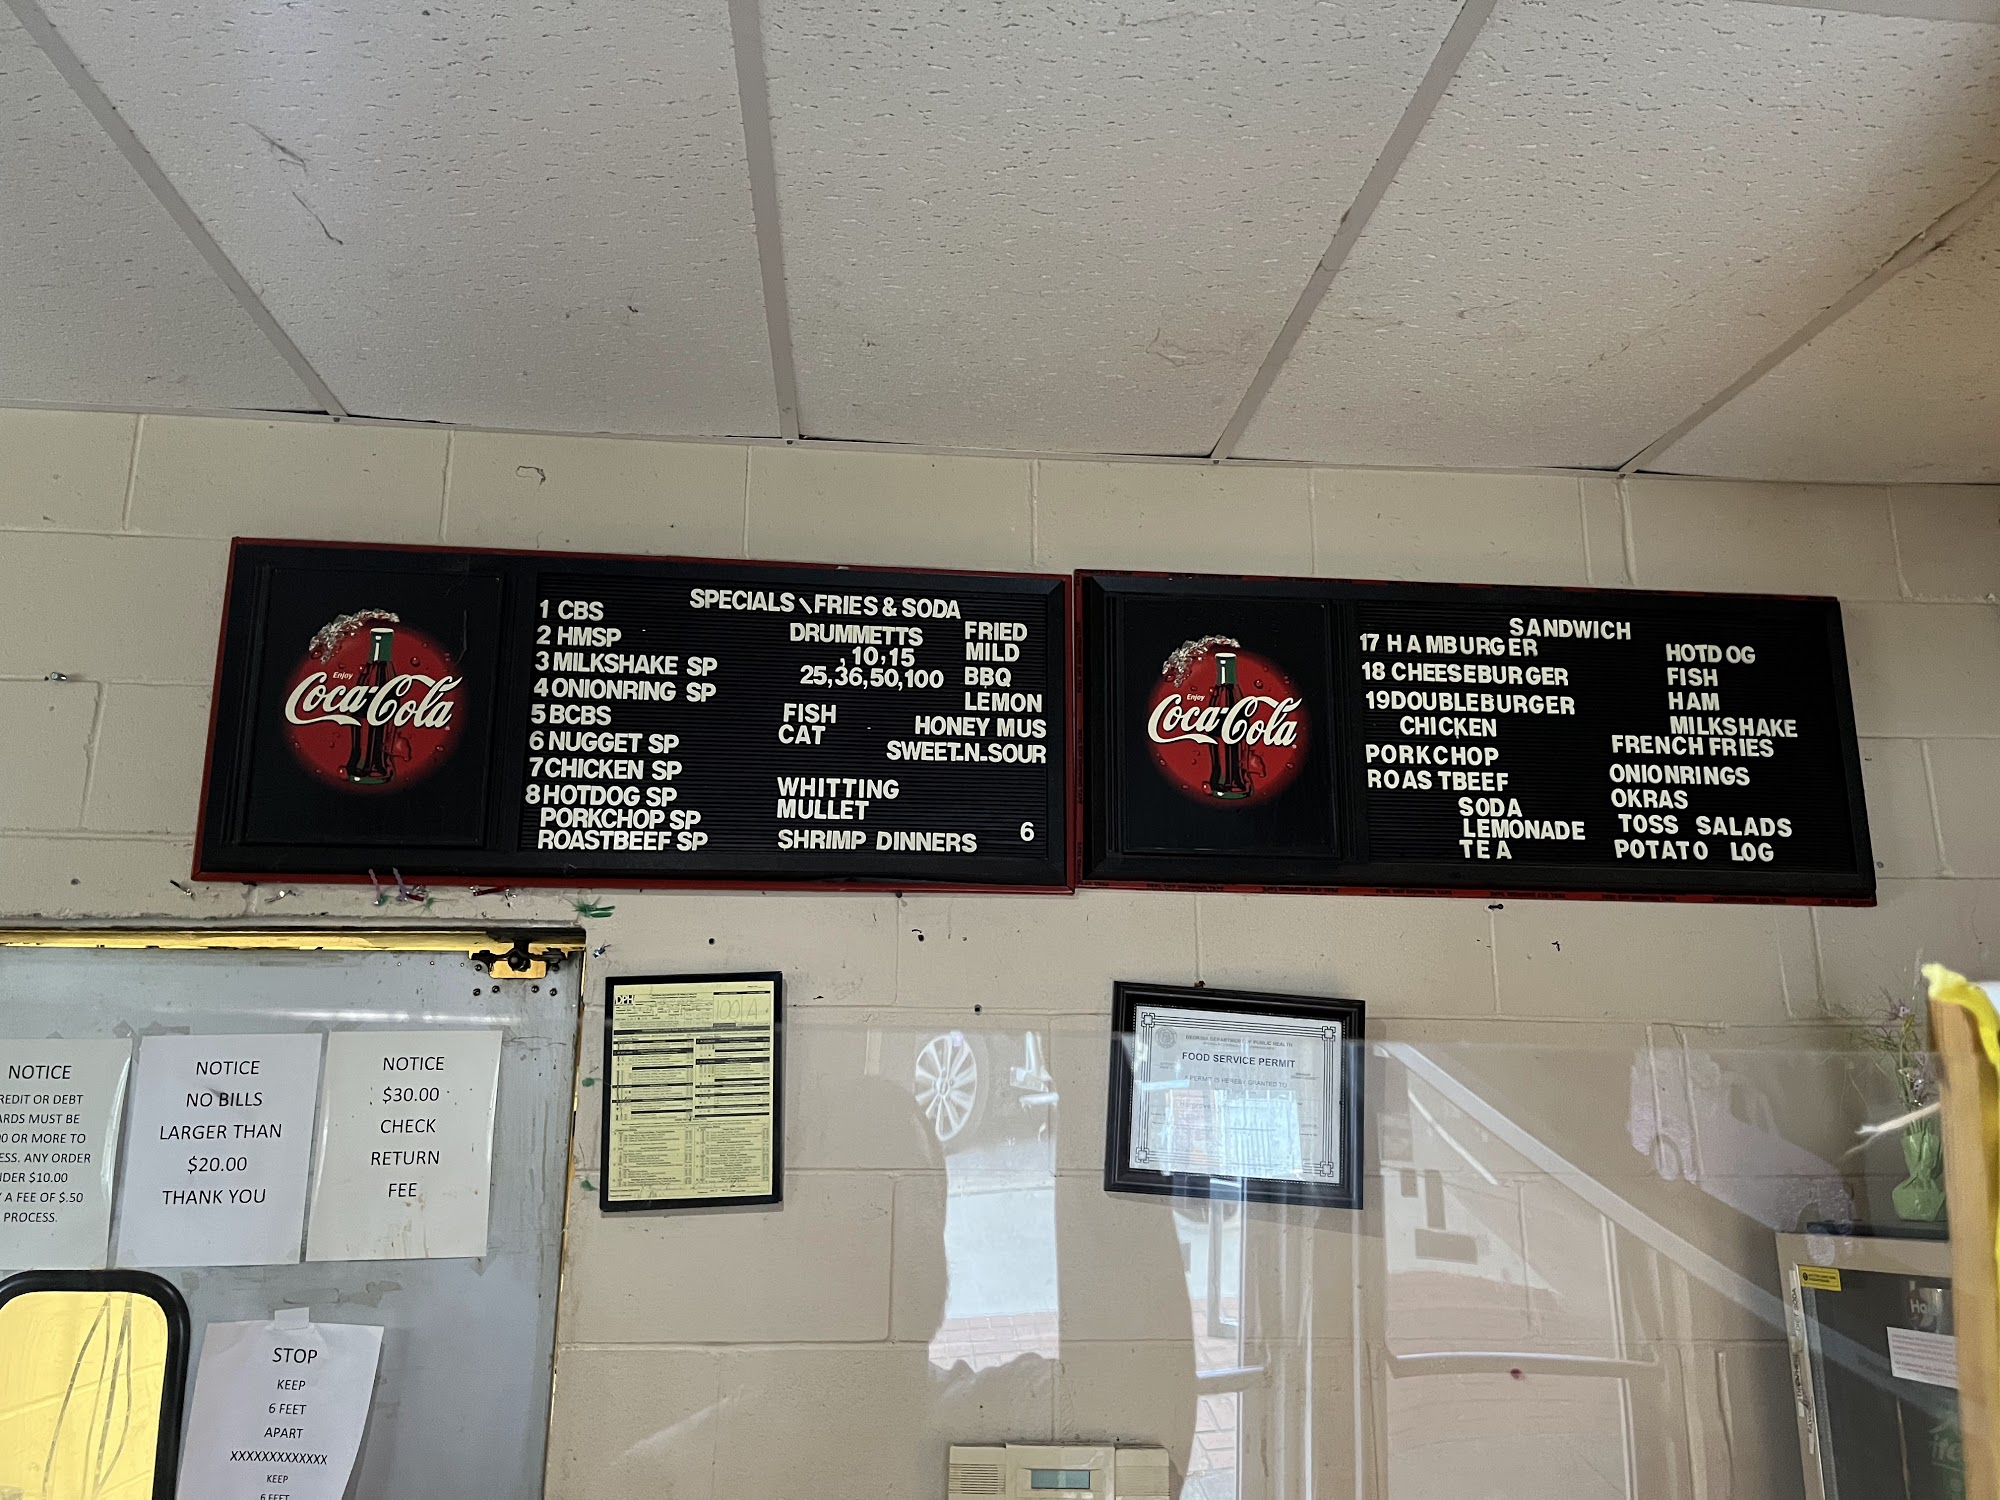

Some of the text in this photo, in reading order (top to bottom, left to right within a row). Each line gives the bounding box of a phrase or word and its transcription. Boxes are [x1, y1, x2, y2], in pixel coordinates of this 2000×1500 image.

[540, 600, 603, 620] 1 CBS
[690, 589, 795, 612] SPECIALS
[882, 597, 897, 616] &
[902, 598, 961, 619] SODA
[537, 625, 621, 647] 2 HMSP
[790, 623, 923, 646] DRUMMETTS
[965, 621, 1027, 641] FRIED
[1510, 618, 1630, 639] SANDWICH
[966, 642, 1019, 661] MILD
[1360, 634, 1379, 651] 17
[535, 651, 717, 676] 3 MILKSHAKE SP
[1362, 662, 1568, 685] 18 CHEESEBURGER
[332, 671, 354, 680] Enjoy
[965, 667, 1011, 688] BBQ
[1668, 668, 1717, 686] FISH
[285, 671, 462, 728] Coca-Cola
[534, 678, 716, 702] 4 ONIONRING SP
[1186, 693, 1206, 703] Enjoy
[965, 692, 1042, 712] LEMON
[1669, 692, 1719, 710] HAM
[532, 704, 611, 725] 5 BCBS
[784, 703, 836, 723] FISH
[1147, 694, 1303, 747] Coca-Cola
[779, 724, 825, 744] CAT
[915, 716, 1046, 738] HONEY MUS
[1400, 716, 1496, 738] CHICKEN
[1670, 716, 1797, 737] MILKSHAKE
[530, 731, 679, 753] 6 NUGGET SP
[1612, 735, 1773, 757] FRENCH FRIES
[1366, 744, 1498, 766] PORKCHOP
[652, 760, 682, 780] SP
[1610, 764, 1750, 785] ONIONRINGS
[526, 784, 677, 807] 8 HOTDOG SP
[777, 777, 899, 799] WHITTING
[1459, 797, 1522, 817] SODA
[1611, 789, 1688, 809] OKRAS
[541, 807, 701, 830] PORKCHOP SP
[777, 799, 869, 820] MULLET
[1021, 822, 1034, 841] 6
[1464, 818, 1585, 840] LEMONADE
[1618, 814, 1792, 837] TOSS SALADS
[538, 830, 708, 851] ROASTBEEF SP
[778, 829, 977, 852] SHRIMP DINNERS
[1459, 840, 1512, 859] TEA
[1614, 839, 1773, 861] POTATO LOG
[616, 994, 635, 1005] DPH
[197, 1061, 260, 1075] NOTICE
[384, 1057, 444, 1070] NOTICE
[1182, 1052, 1295, 1068] FOOD SERVICE PERMIT
[9, 1065, 71, 1079] NOTICE
[33, 1095, 50, 1104] OR
[53, 1095, 83, 1104] DEBT
[187, 1092, 262, 1107] NO BILLS
[383, 1087, 439, 1104] $30.00
[29, 1114, 63, 1123] MUST
[66, 1114, 80, 1123] BE
[381, 1119, 435, 1133] CHECK
[12, 1134, 27, 1143] OR
[32, 1134, 66, 1143] MORE
[70, 1134, 86, 1143] TO
[160, 1124, 281, 1139] LARGER THAN
[24, 1154, 48, 1163] ANY
[52, 1153, 91, 1163] ORDER
[188, 1156, 247, 1174] $20.00
[371, 1151, 439, 1165] RETURN
[29, 1172, 68, 1183] $10.00
[5, 1193, 12, 1202] A
[17, 1193, 36, 1202] FEE
[40, 1193, 55, 1202] OF
[59, 1192, 83, 1203] $.50
[163, 1189, 265, 1204] THANK YOU
[389, 1183, 417, 1197] FEE
[4, 1212, 57, 1222] PROCESS.
[273, 1348, 317, 1363] STOP
[277, 1380, 305, 1390] KEEP
[269, 1403, 306, 1414] 6 FEET
[264, 1427, 303, 1438] APART
[267, 1475, 288, 1483] KEEP
